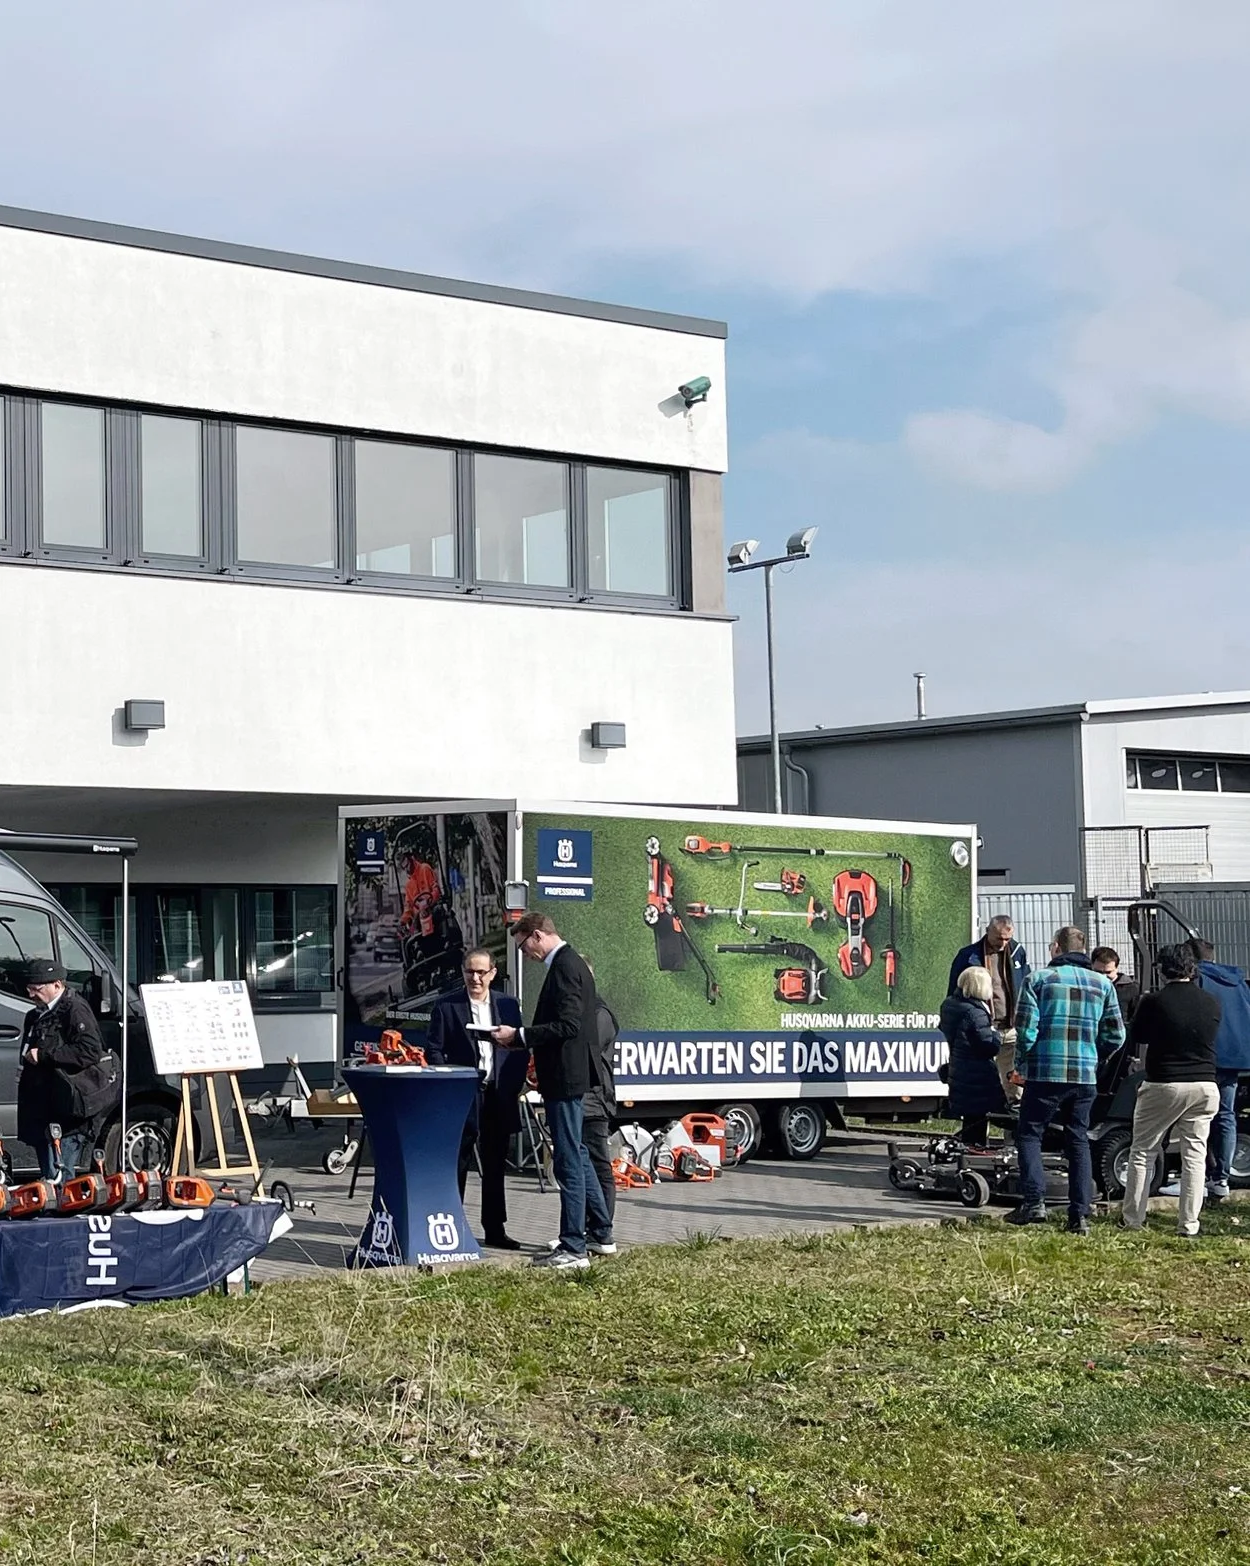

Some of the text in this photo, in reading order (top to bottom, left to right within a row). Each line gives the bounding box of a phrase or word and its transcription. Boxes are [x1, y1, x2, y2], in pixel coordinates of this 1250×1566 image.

[544, 887, 586, 897] PROFESSIONAL
[781, 1013, 844, 1029] HUSQVARNA
[845, 1013, 905, 1029] AKKU-SERIE
[906, 1011, 926, 1029] FÜR
[613, 1041, 744, 1076] ERWARTEN
[749, 1041, 787, 1075] SIE
[792, 1040, 839, 1074] DAS
[417, 1251, 480, 1265] Husqvarna
